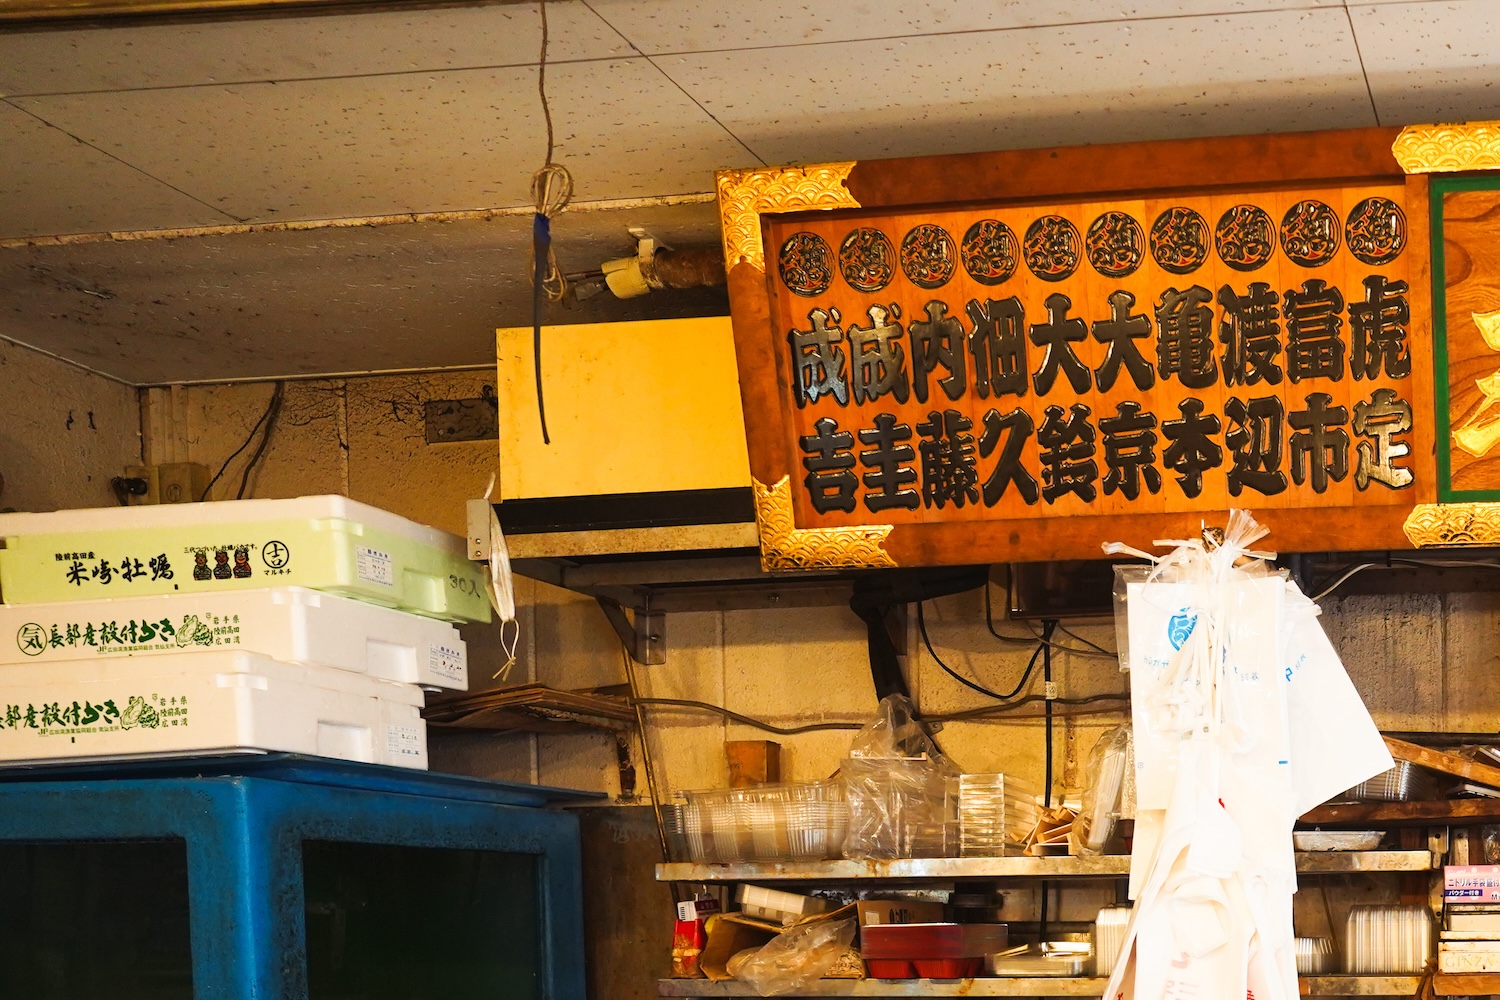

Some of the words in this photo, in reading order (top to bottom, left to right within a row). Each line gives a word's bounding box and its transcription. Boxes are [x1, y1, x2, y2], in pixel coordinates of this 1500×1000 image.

[1091, 289, 1162, 500] 大京
[1282, 279, 1351, 495] 富市
[1348, 273, 1416, 491] 虎定
[908, 299, 980, 510] 内藤
[968, 294, 1040, 507] 佃久
[1029, 292, 1099, 506] 大鈴
[213, 616, 240, 625] 岩手県
[213, 625, 240, 635] 陸前高田
[20, 625, 45, 653] 気
[214, 635, 241, 645] 広田湾
[0, 699, 120, 730] 部産殻付かき
[160, 695, 188, 706] 岩手県
[160, 707, 188, 717] 陸前高田
[161, 717, 188, 728] 広田湾
[1445, 956, 1493, 967] GINZA
